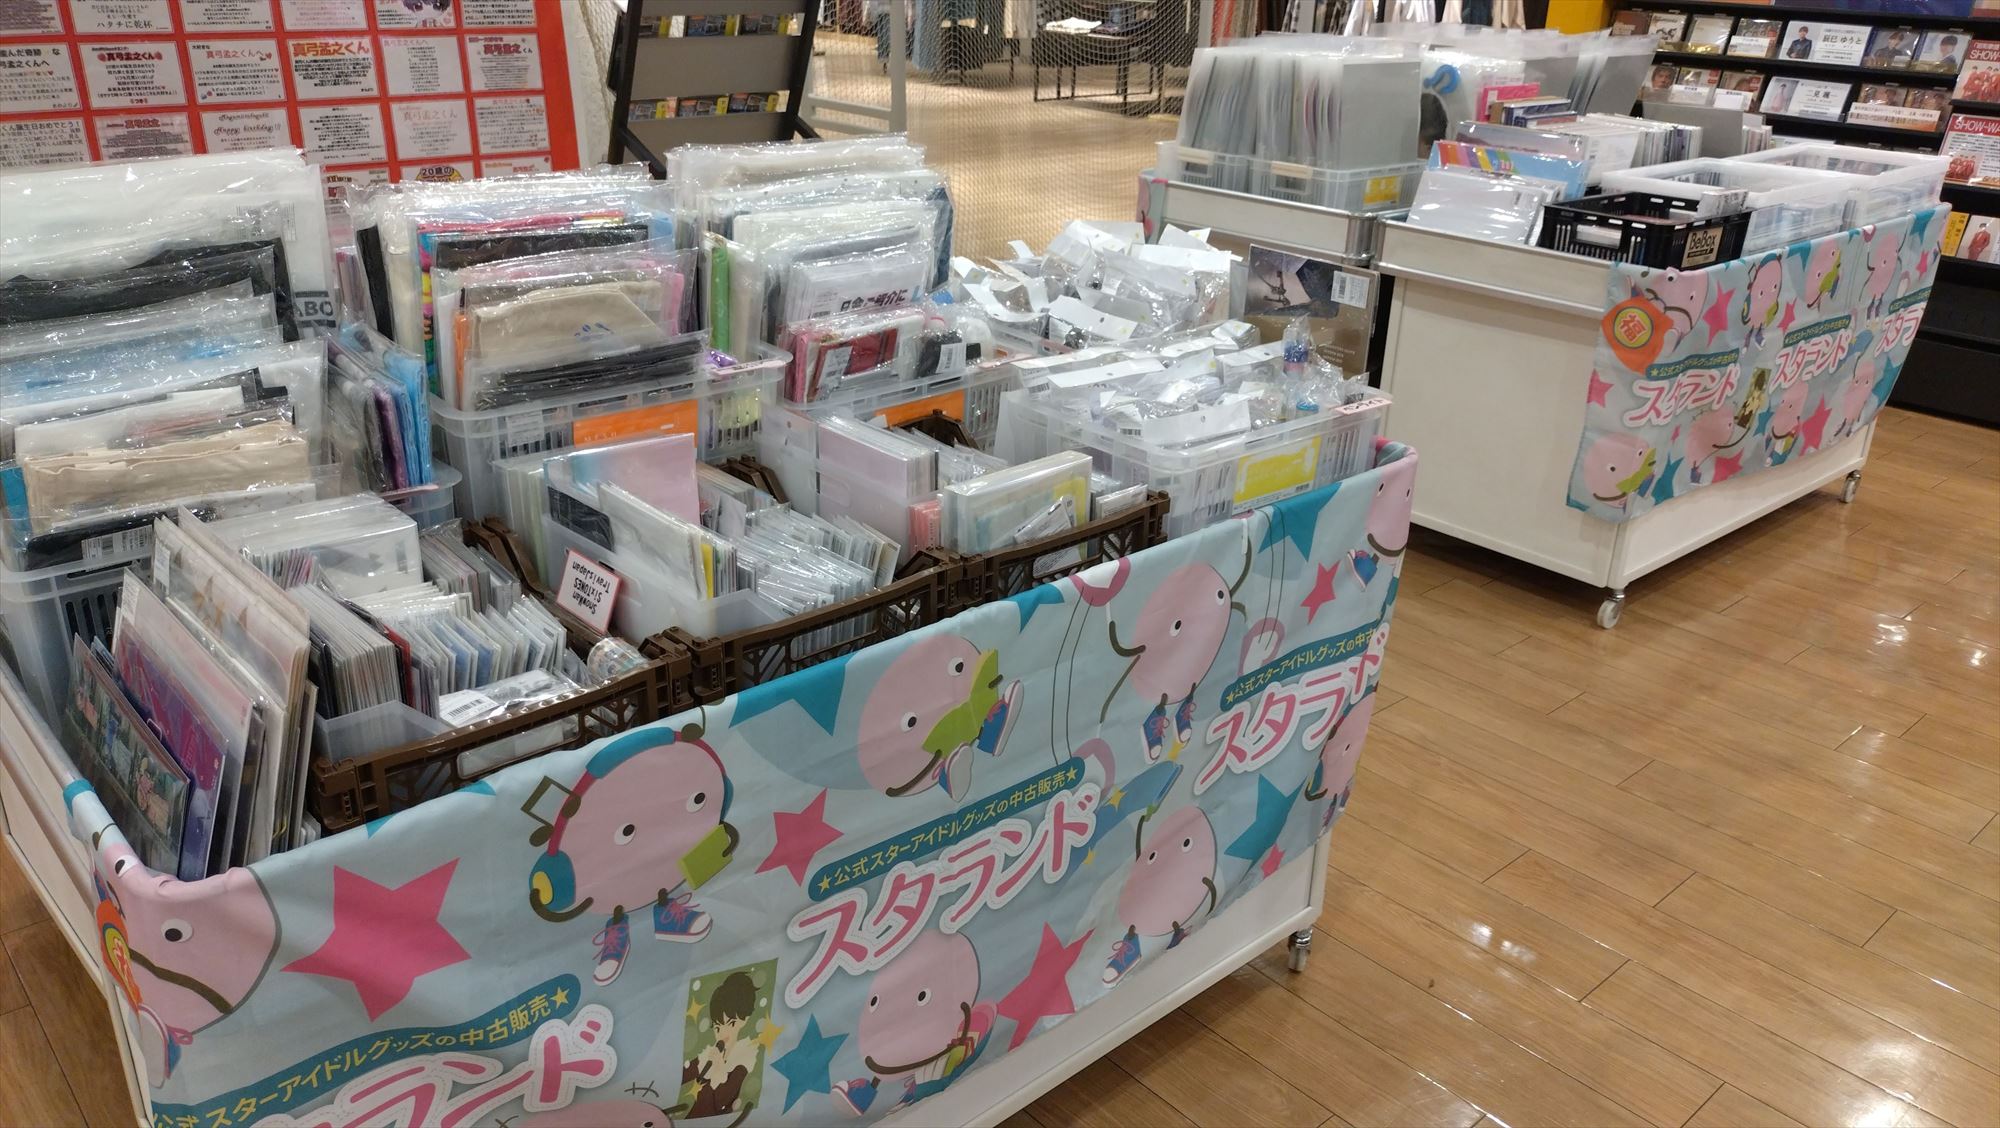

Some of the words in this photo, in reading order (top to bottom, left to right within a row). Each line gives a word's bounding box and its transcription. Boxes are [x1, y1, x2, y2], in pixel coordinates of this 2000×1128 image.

[1689, 231, 1717, 250] BeBox
[1619, 312, 1647, 343] 福
[1771, 333, 1850, 386] スタランド
[572, 591, 598, 615] SnowMan
[833, 770, 1068, 885] 公式スターアイドルグッズの中古販売
[795, 792, 1096, 998] スタランド
